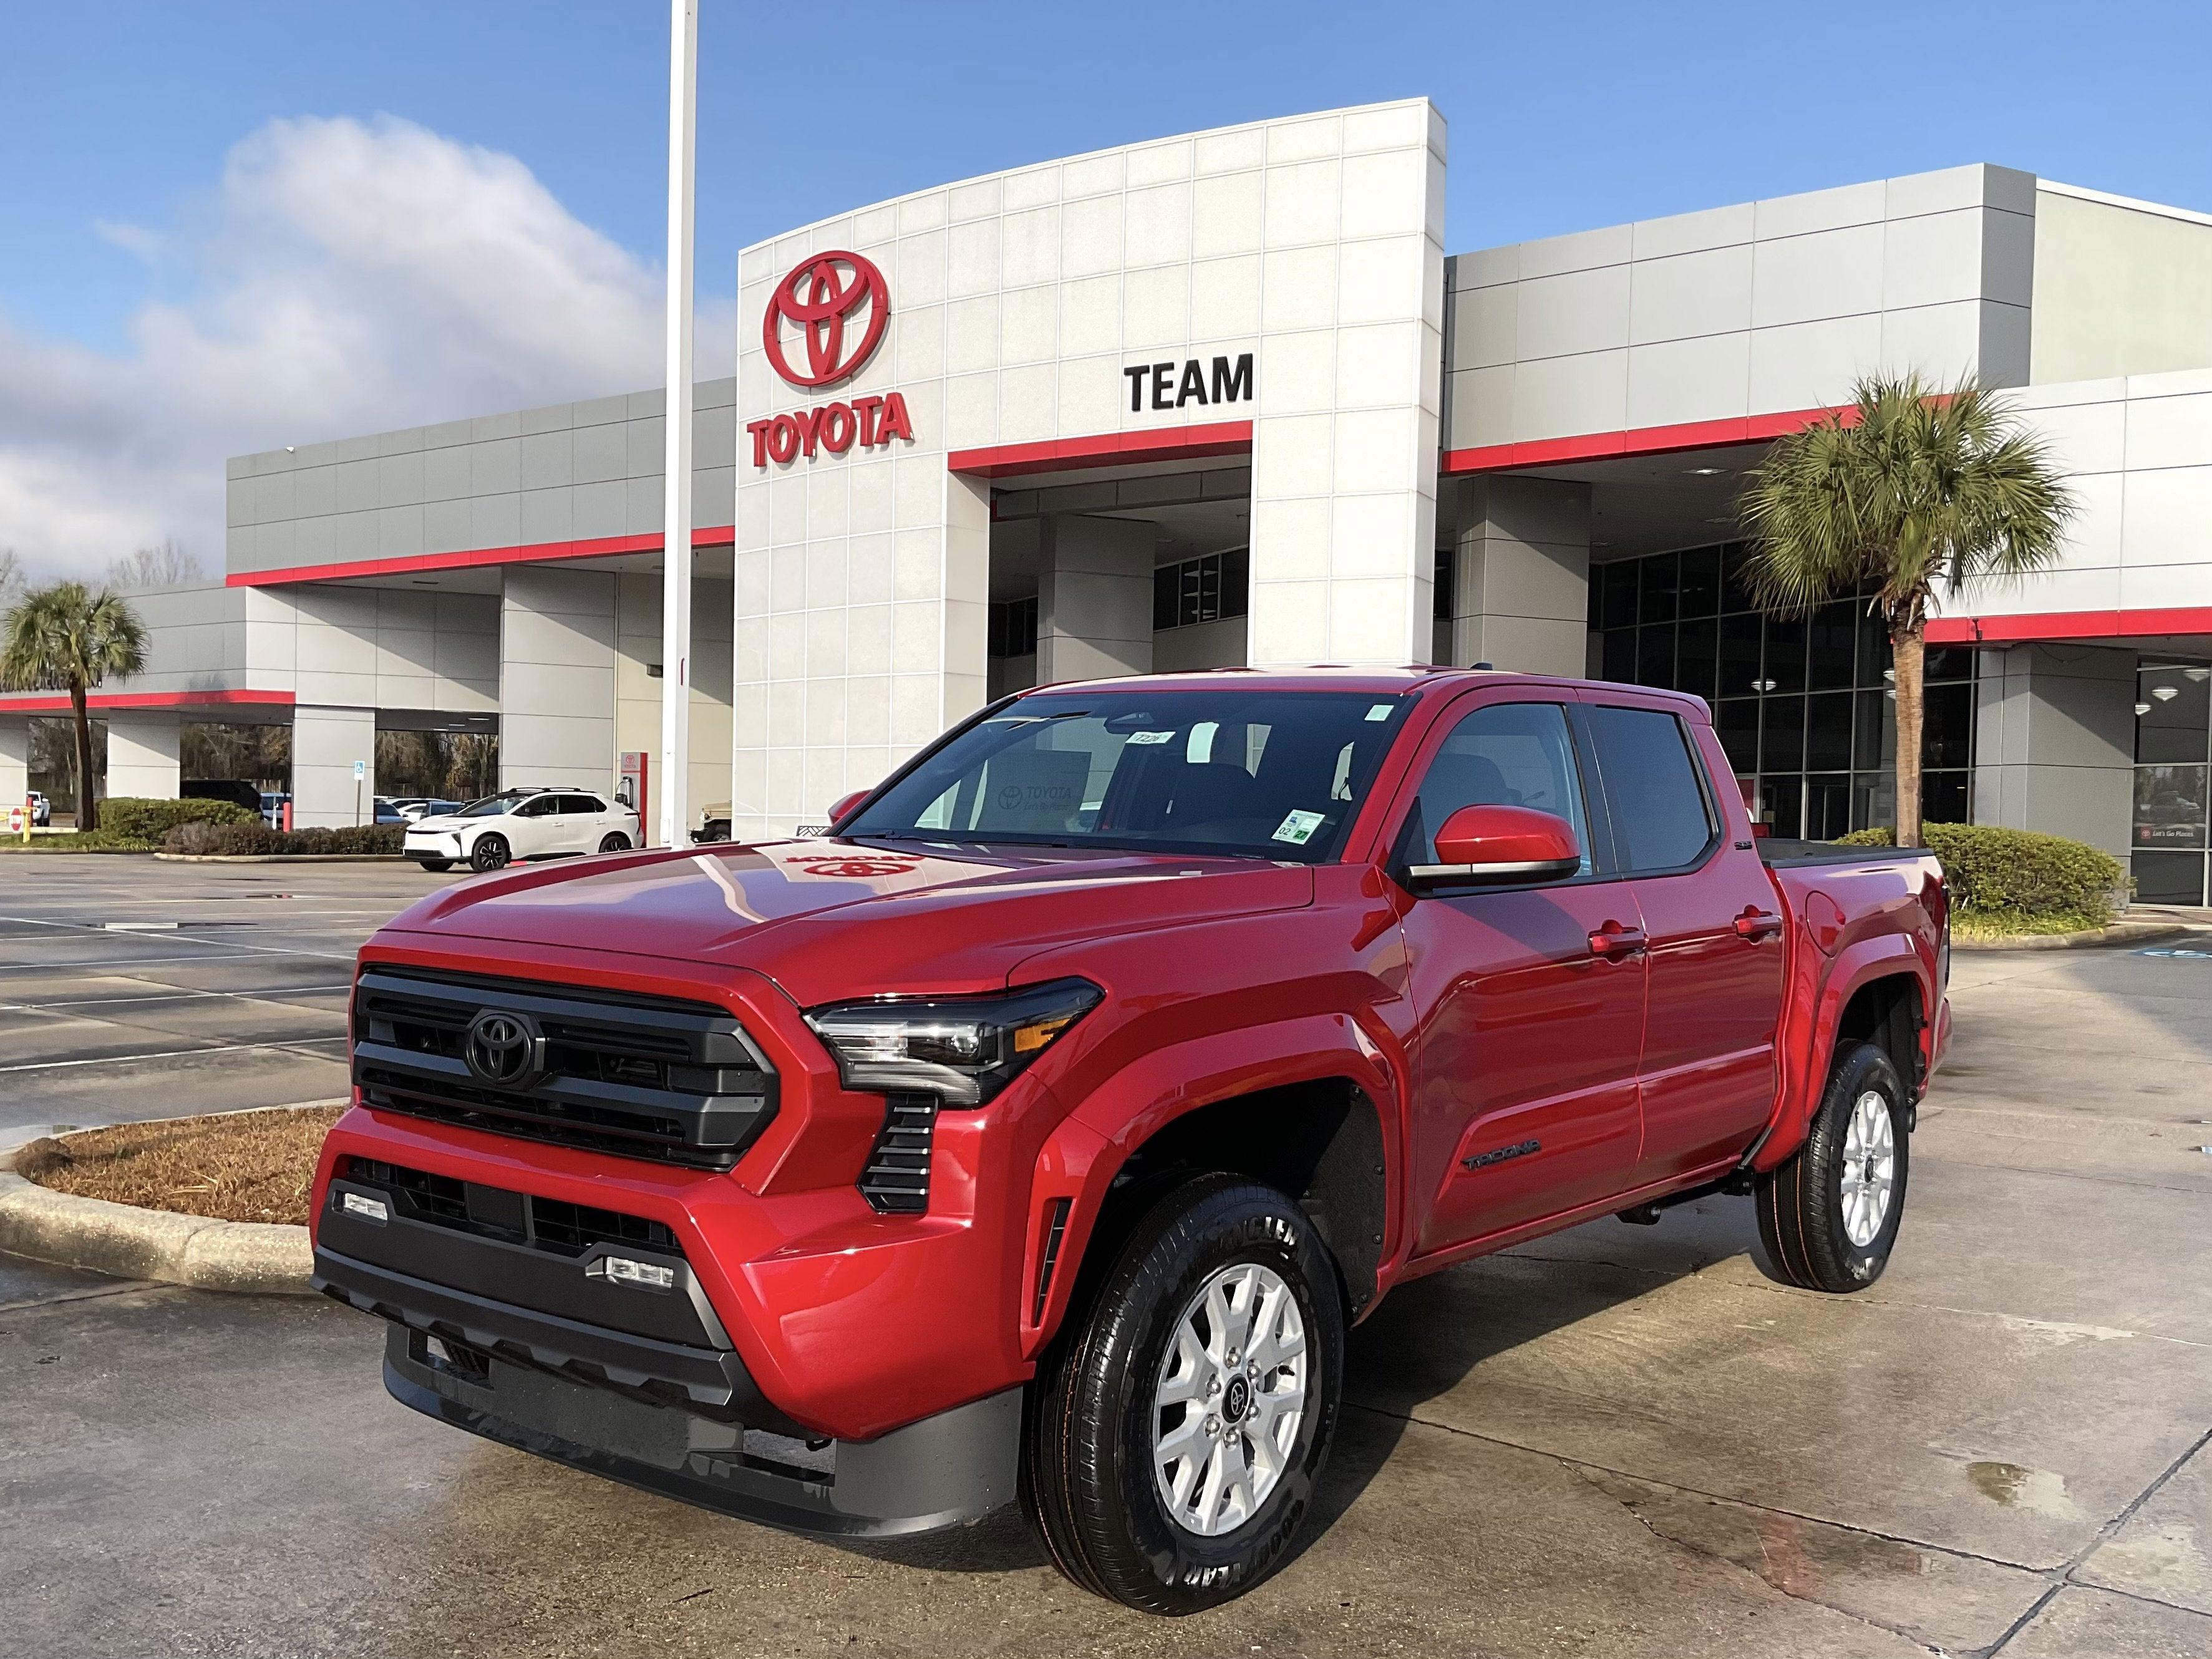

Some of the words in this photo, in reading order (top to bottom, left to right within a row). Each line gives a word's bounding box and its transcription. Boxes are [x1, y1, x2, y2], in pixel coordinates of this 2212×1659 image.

[1123, 353, 1253, 412] TEAM
[747, 392, 915, 468] TOYOTA
[1027, 786, 1071, 800] TOYOTA
[1278, 827, 1291, 836] 02
[1294, 830, 1308, 840] 27
[1462, 1139, 1541, 1171] TACOMA
